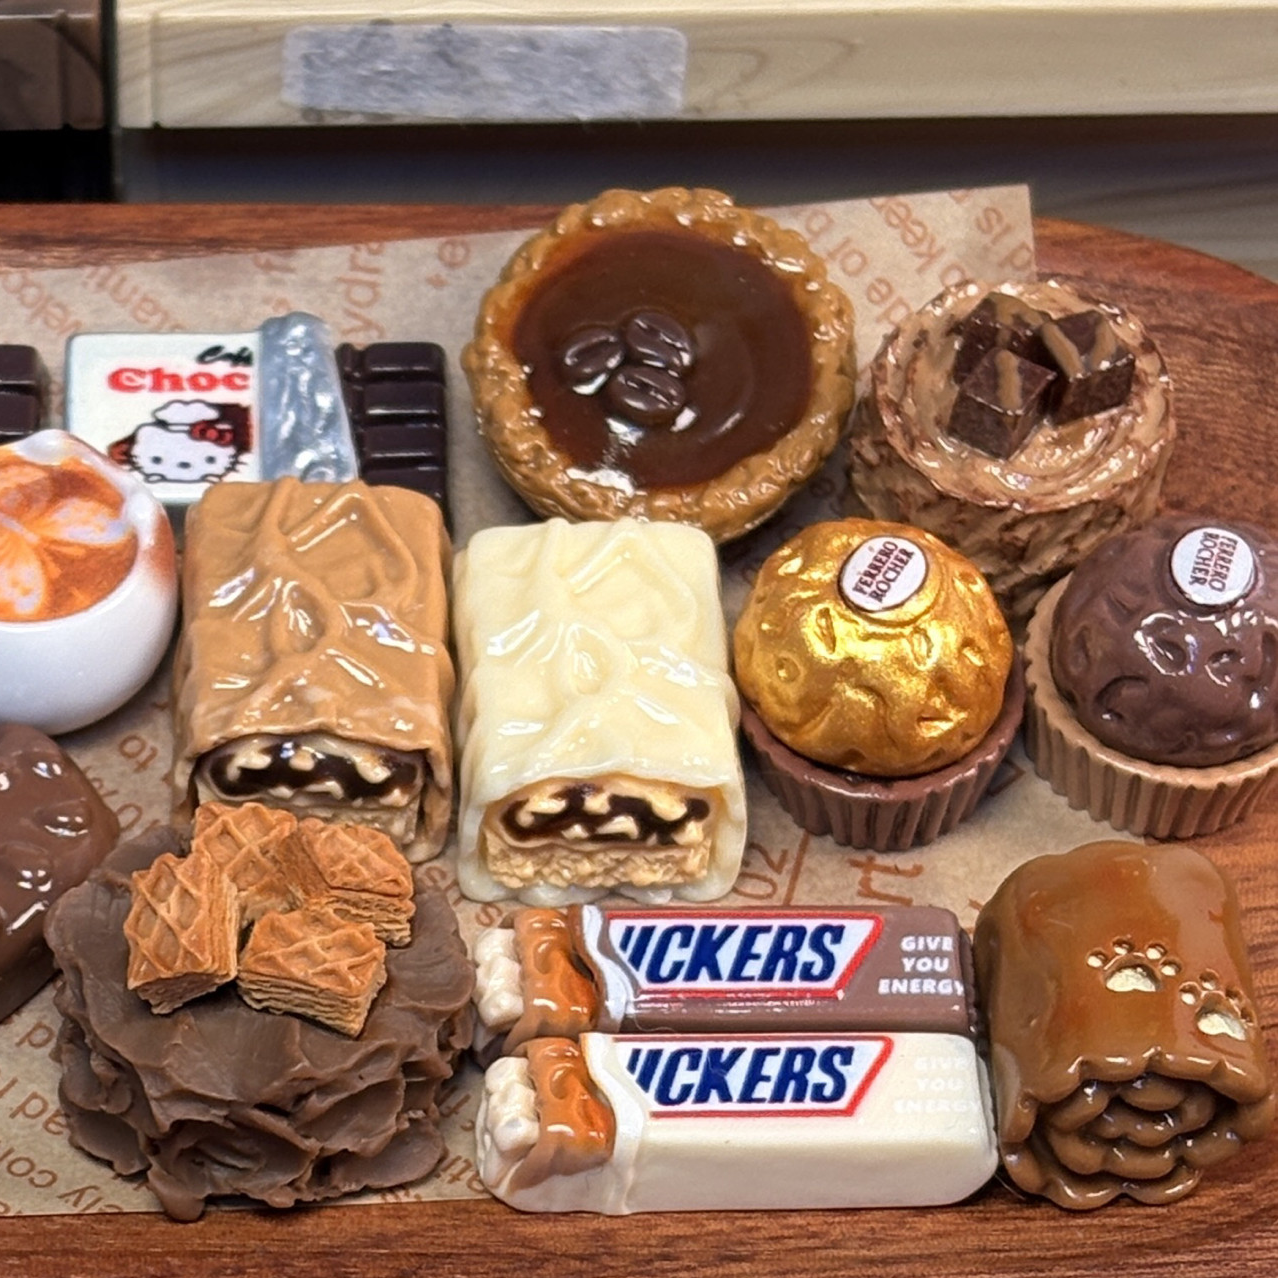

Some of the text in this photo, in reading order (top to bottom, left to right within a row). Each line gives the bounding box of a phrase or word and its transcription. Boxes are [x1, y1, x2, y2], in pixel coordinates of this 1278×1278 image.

[108, 367, 251, 393] Choc
[852, 541, 899, 595] FERRERO
[1188, 530, 1221, 586] ROCHER
[1208, 535, 1239, 592] FERRERO
[868, 548, 916, 603] ROCHER
[900, 936, 955, 952] GIVE
[902, 957, 950, 973] YOU
[878, 978, 965, 997] ENERGY
[916, 1077, 965, 1092] YOU
